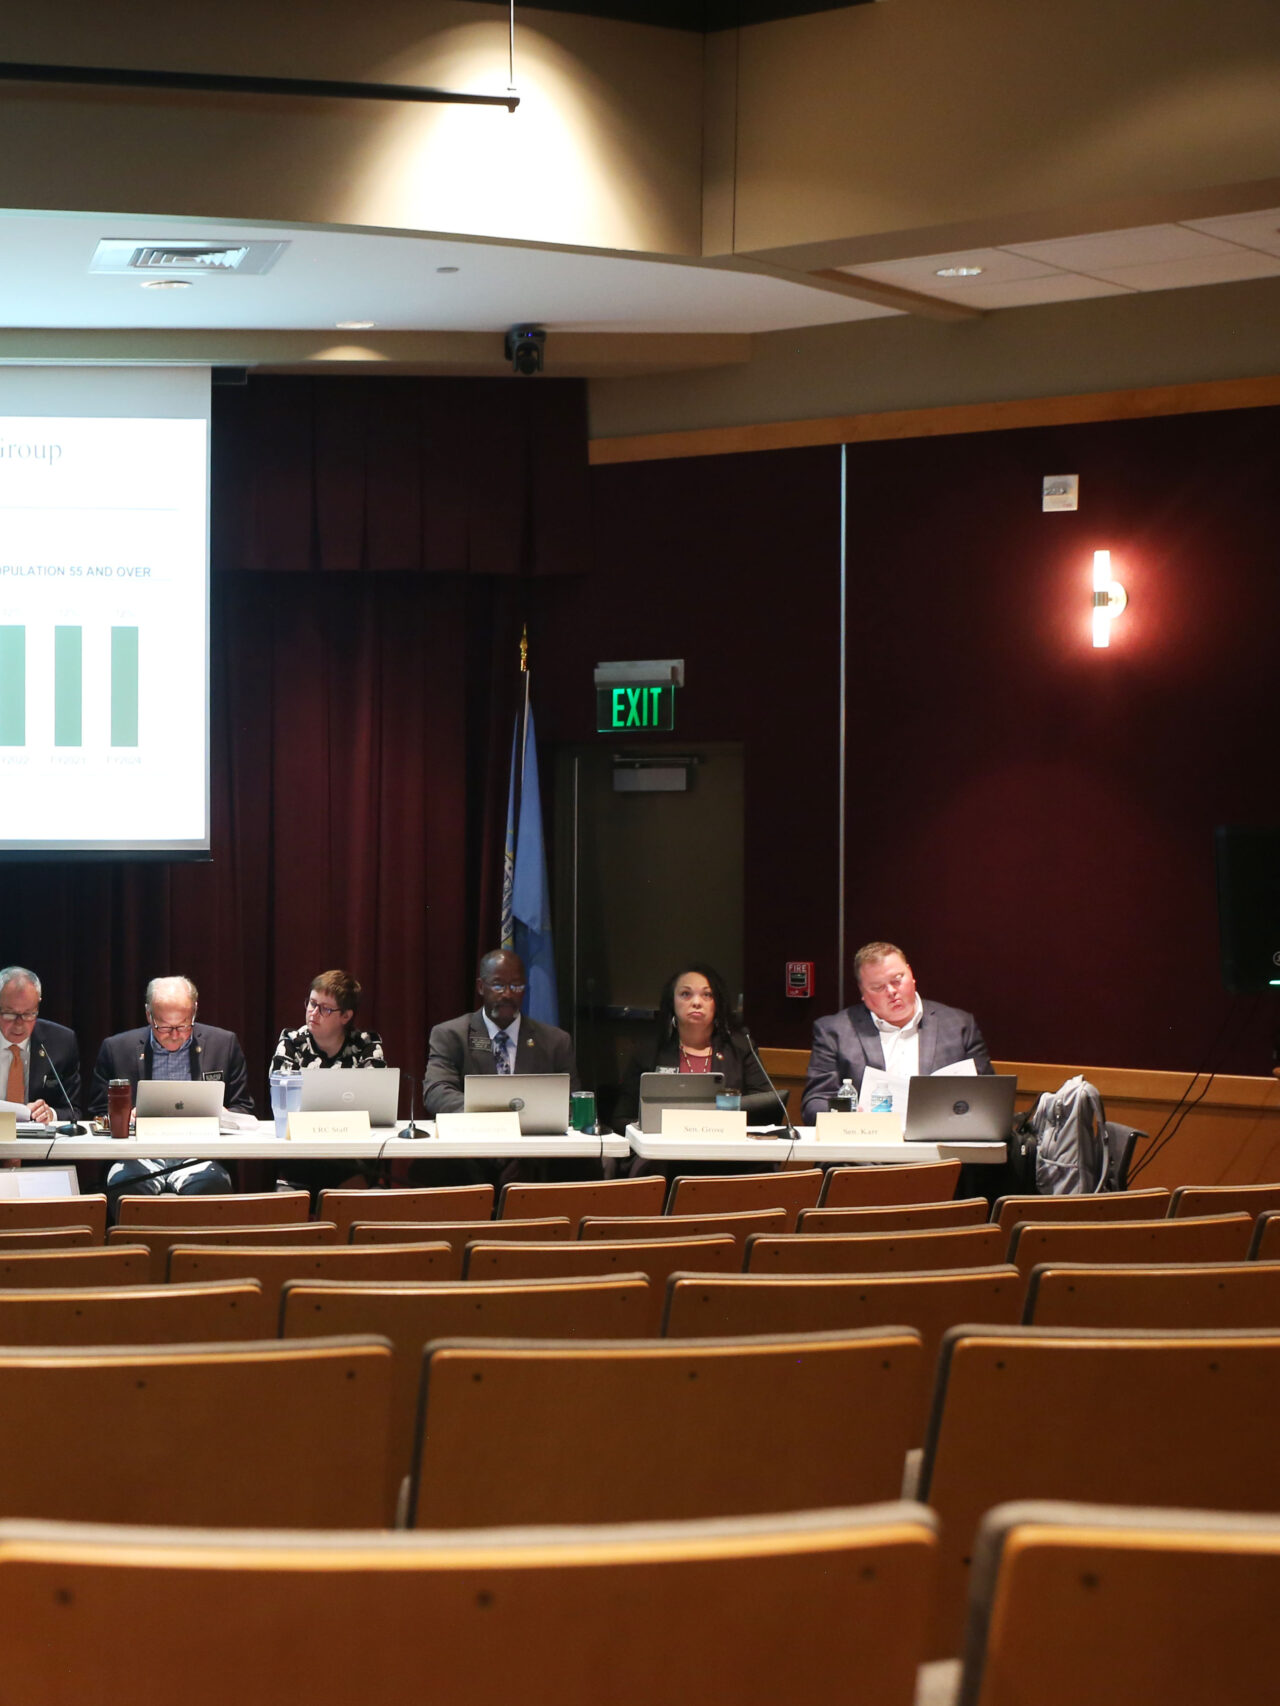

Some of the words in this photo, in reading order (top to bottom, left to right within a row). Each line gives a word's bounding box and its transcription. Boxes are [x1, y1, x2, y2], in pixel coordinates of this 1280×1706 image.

[69, 565, 83, 577] 55
[86, 566, 113, 577] AND
[116, 566, 152, 578] OVER
[611, 687, 662, 728] EXIT
[788, 964, 807, 973] FIRE
